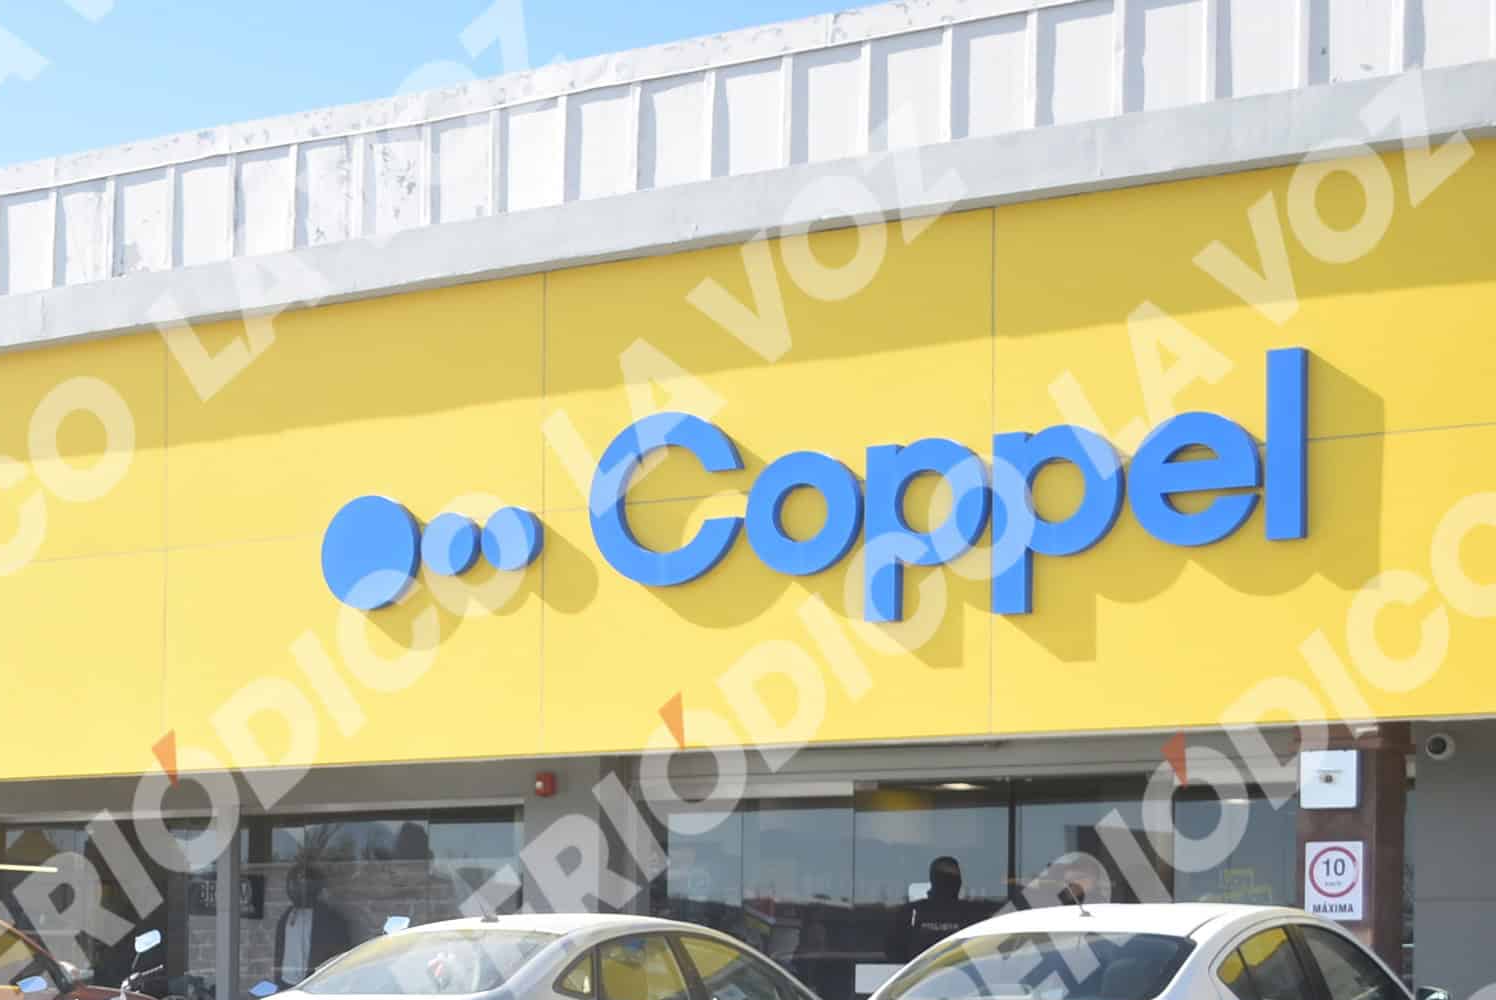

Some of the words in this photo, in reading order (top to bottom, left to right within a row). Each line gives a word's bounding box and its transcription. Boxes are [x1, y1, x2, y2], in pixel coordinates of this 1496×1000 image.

[590, 347, 1309, 623] Coppel
[1323, 858, 1346, 877] 10
[1312, 902, 1354, 913] MÁXIMA
